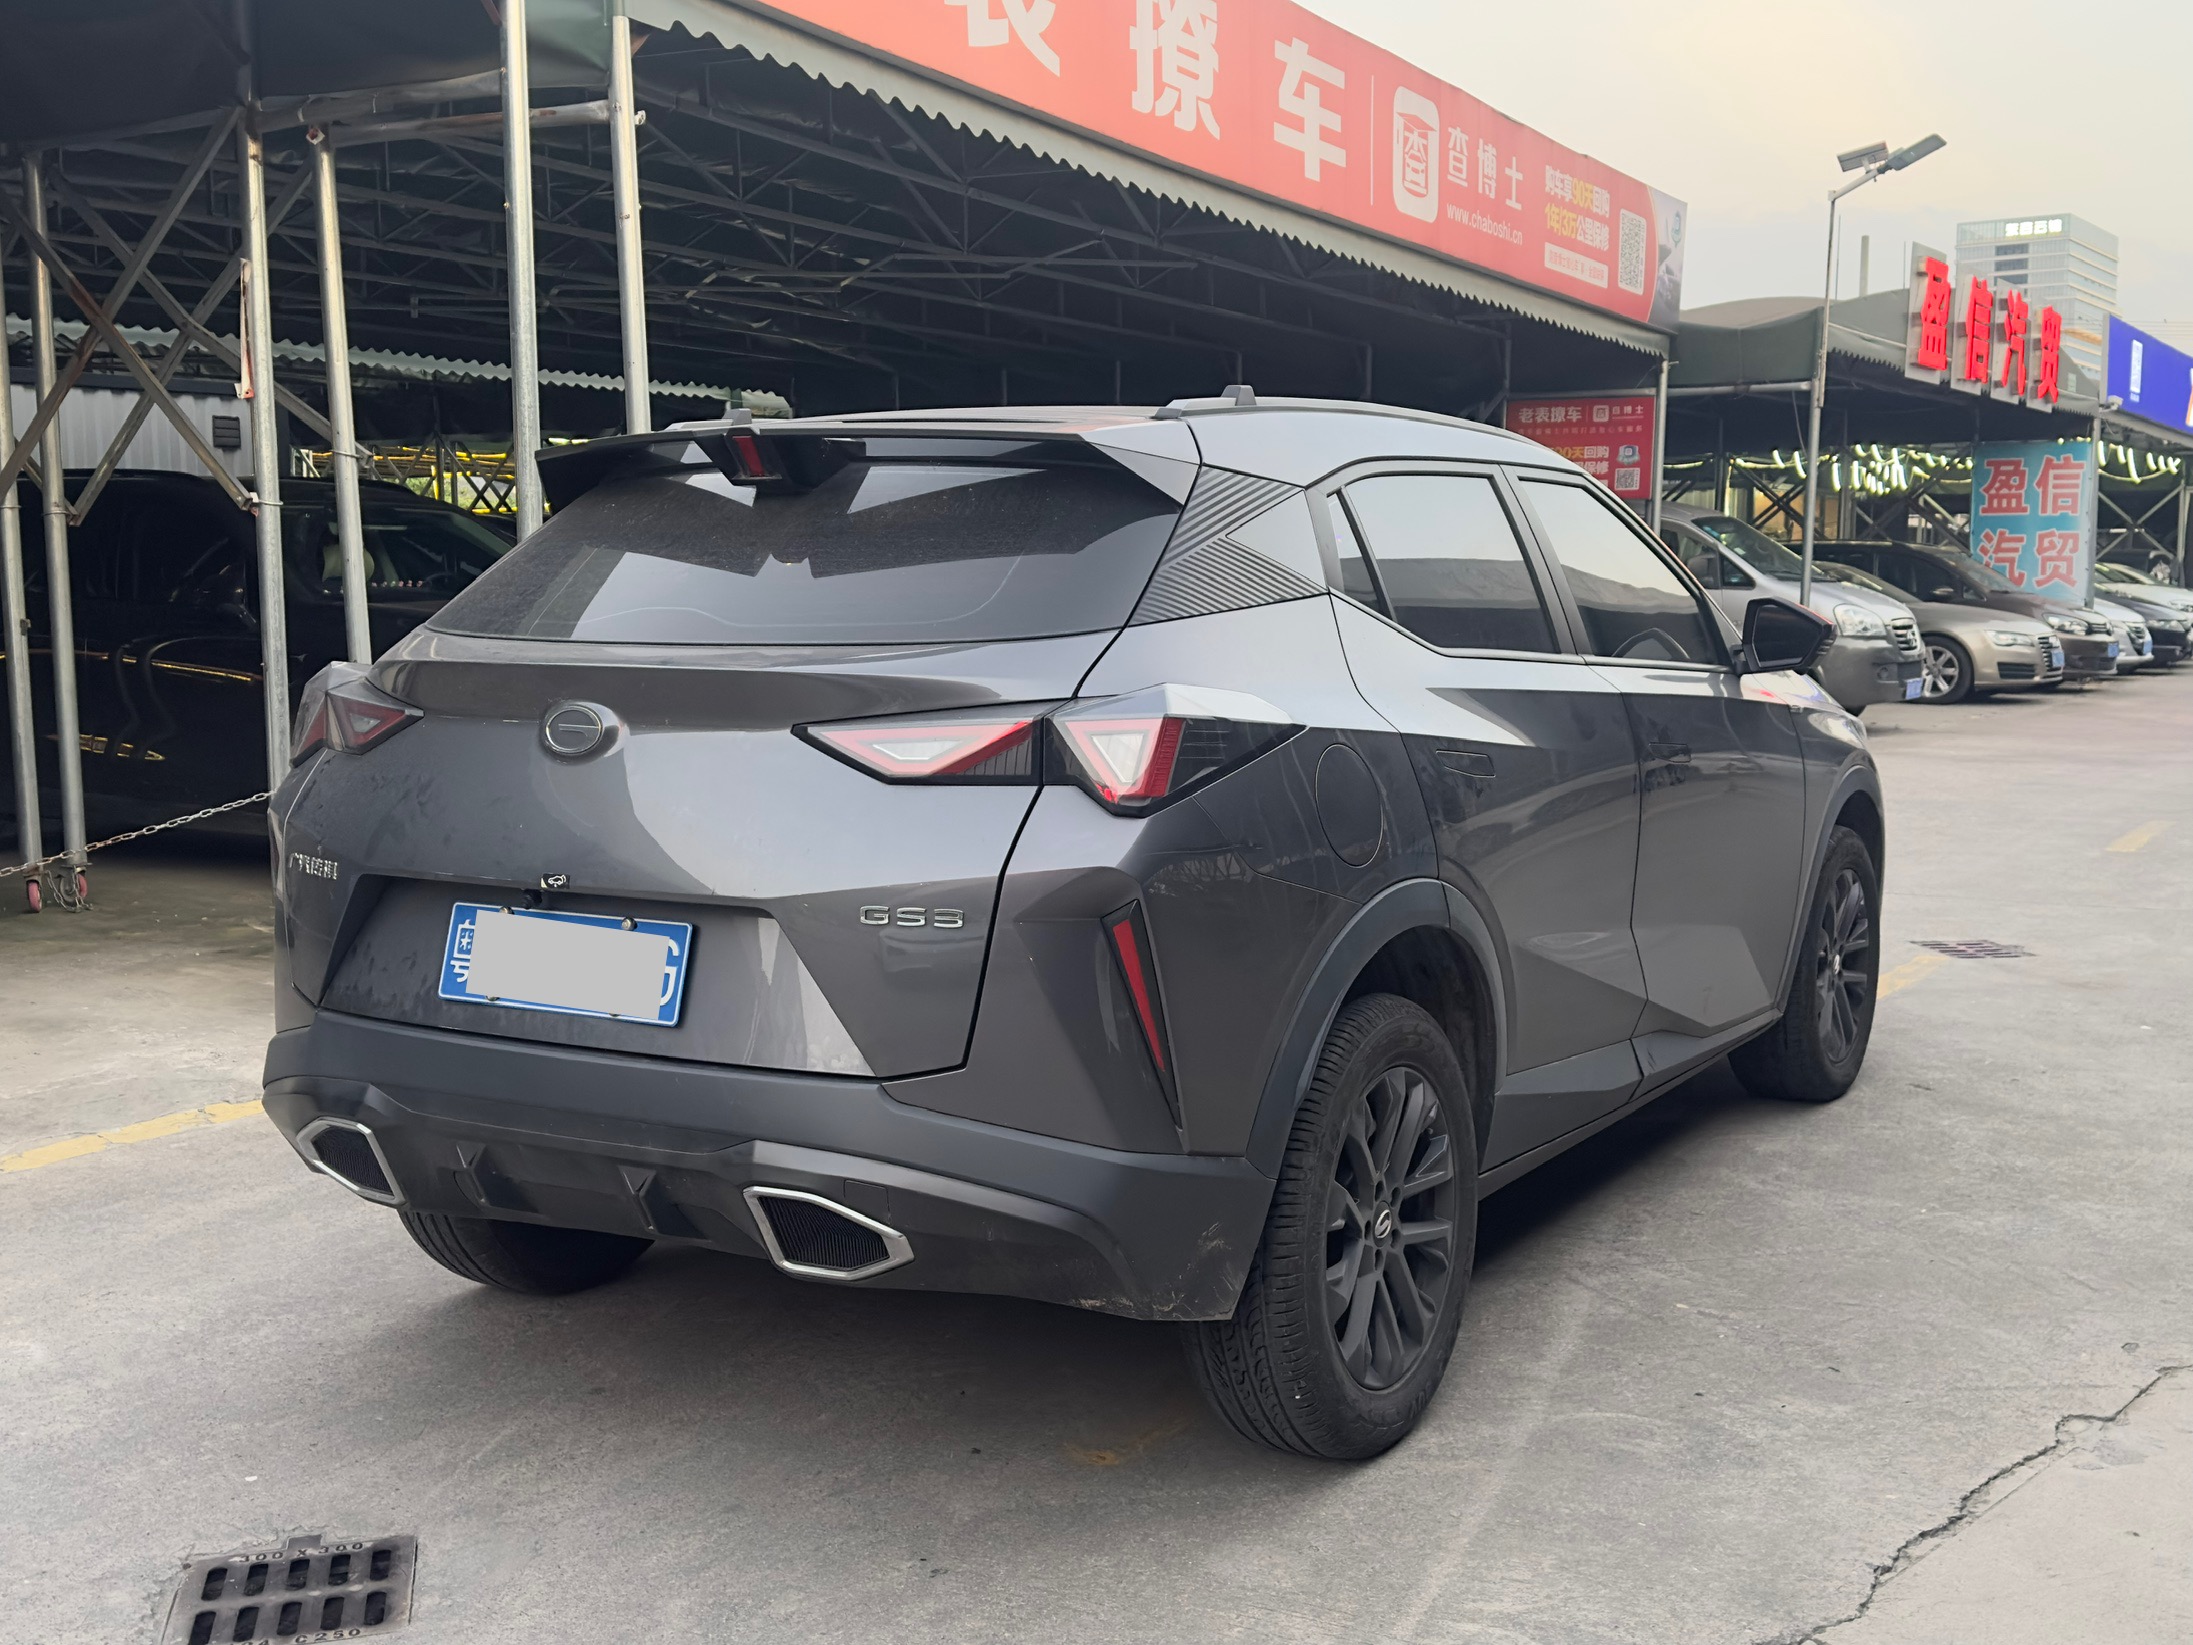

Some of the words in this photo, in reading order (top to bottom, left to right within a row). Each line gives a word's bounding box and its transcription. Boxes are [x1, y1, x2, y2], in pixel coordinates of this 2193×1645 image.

[1447, 126, 1524, 211] 查博士
[1446, 203, 1523, 246] www.chaboshi.cn
[1918, 255, 2063, 404] 盈信汽贸
[1551, 445, 1610, 459] 90天回购
[1979, 454, 2086, 516] 盈信
[1977, 528, 2080, 589] 汽贸
[860, 905, 963, 928] GS3
